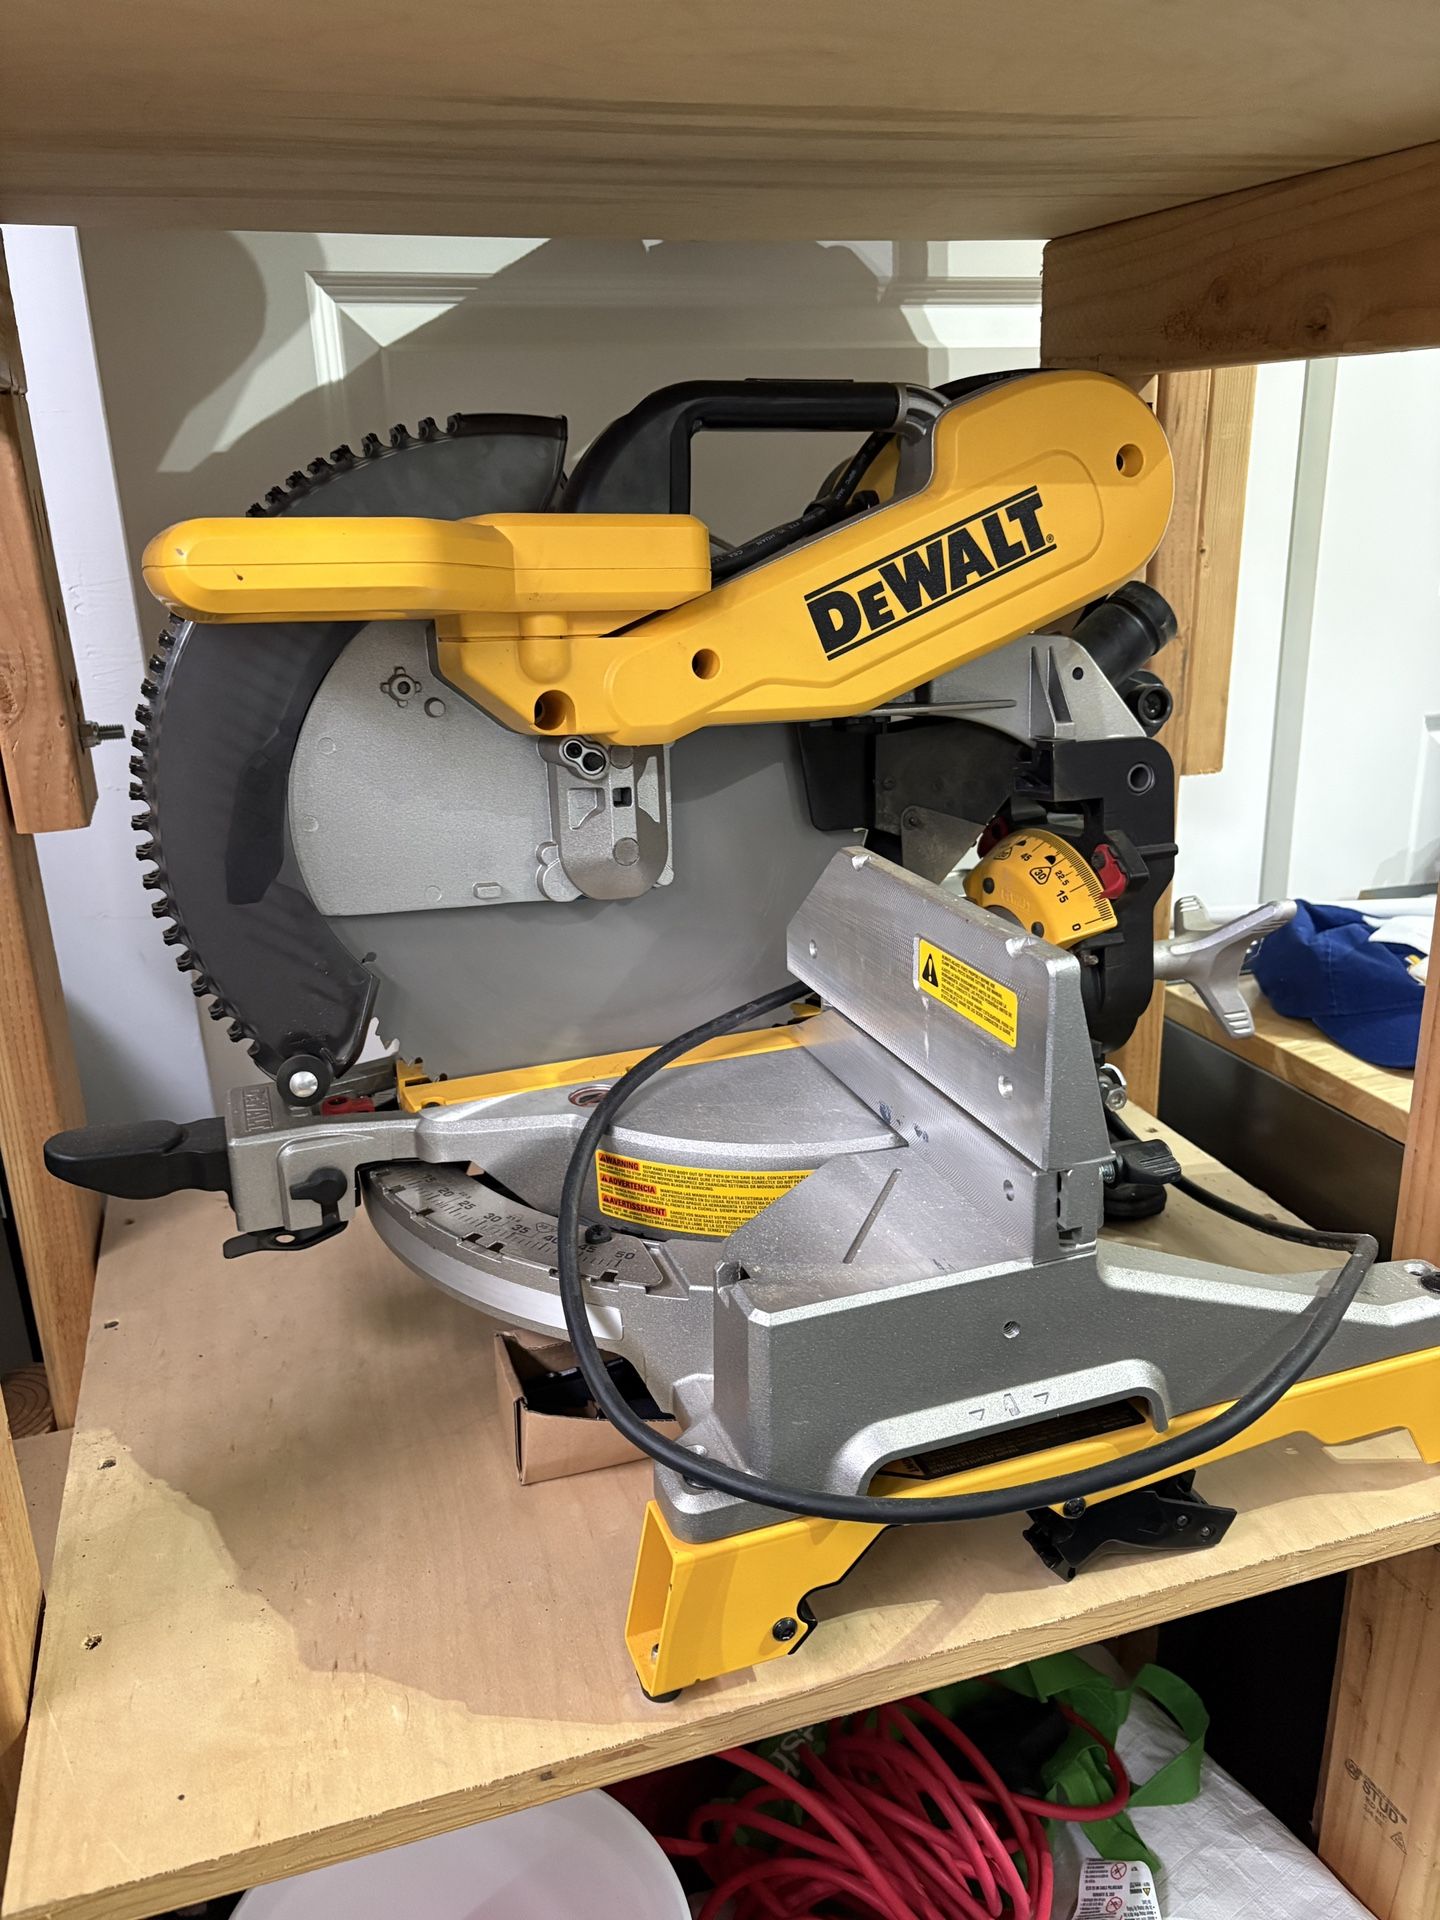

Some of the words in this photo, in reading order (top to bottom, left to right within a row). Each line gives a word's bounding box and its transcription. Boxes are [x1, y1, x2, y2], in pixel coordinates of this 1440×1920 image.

[806, 492, 1047, 653] DEWALT
[1020, 853, 1033, 862] 45
[1034, 869, 1047, 881] 30
[1056, 890, 1069, 903] 15
[1072, 923, 1081, 931] 0
[606, 1155, 638, 1170] WARNING
[609, 1175, 654, 1193] ADVERTENCIA
[438, 1187, 453, 1197] 20
[458, 1200, 476, 1210] 25
[610, 1196, 664, 1216] AVERTISSEMENT
[484, 1212, 502, 1222] 30
[512, 1224, 531, 1234] 35
[578, 1244, 597, 1253] 45
[615, 1251, 636, 1260] 50
[1362, 1781, 1398, 1824] STUD
